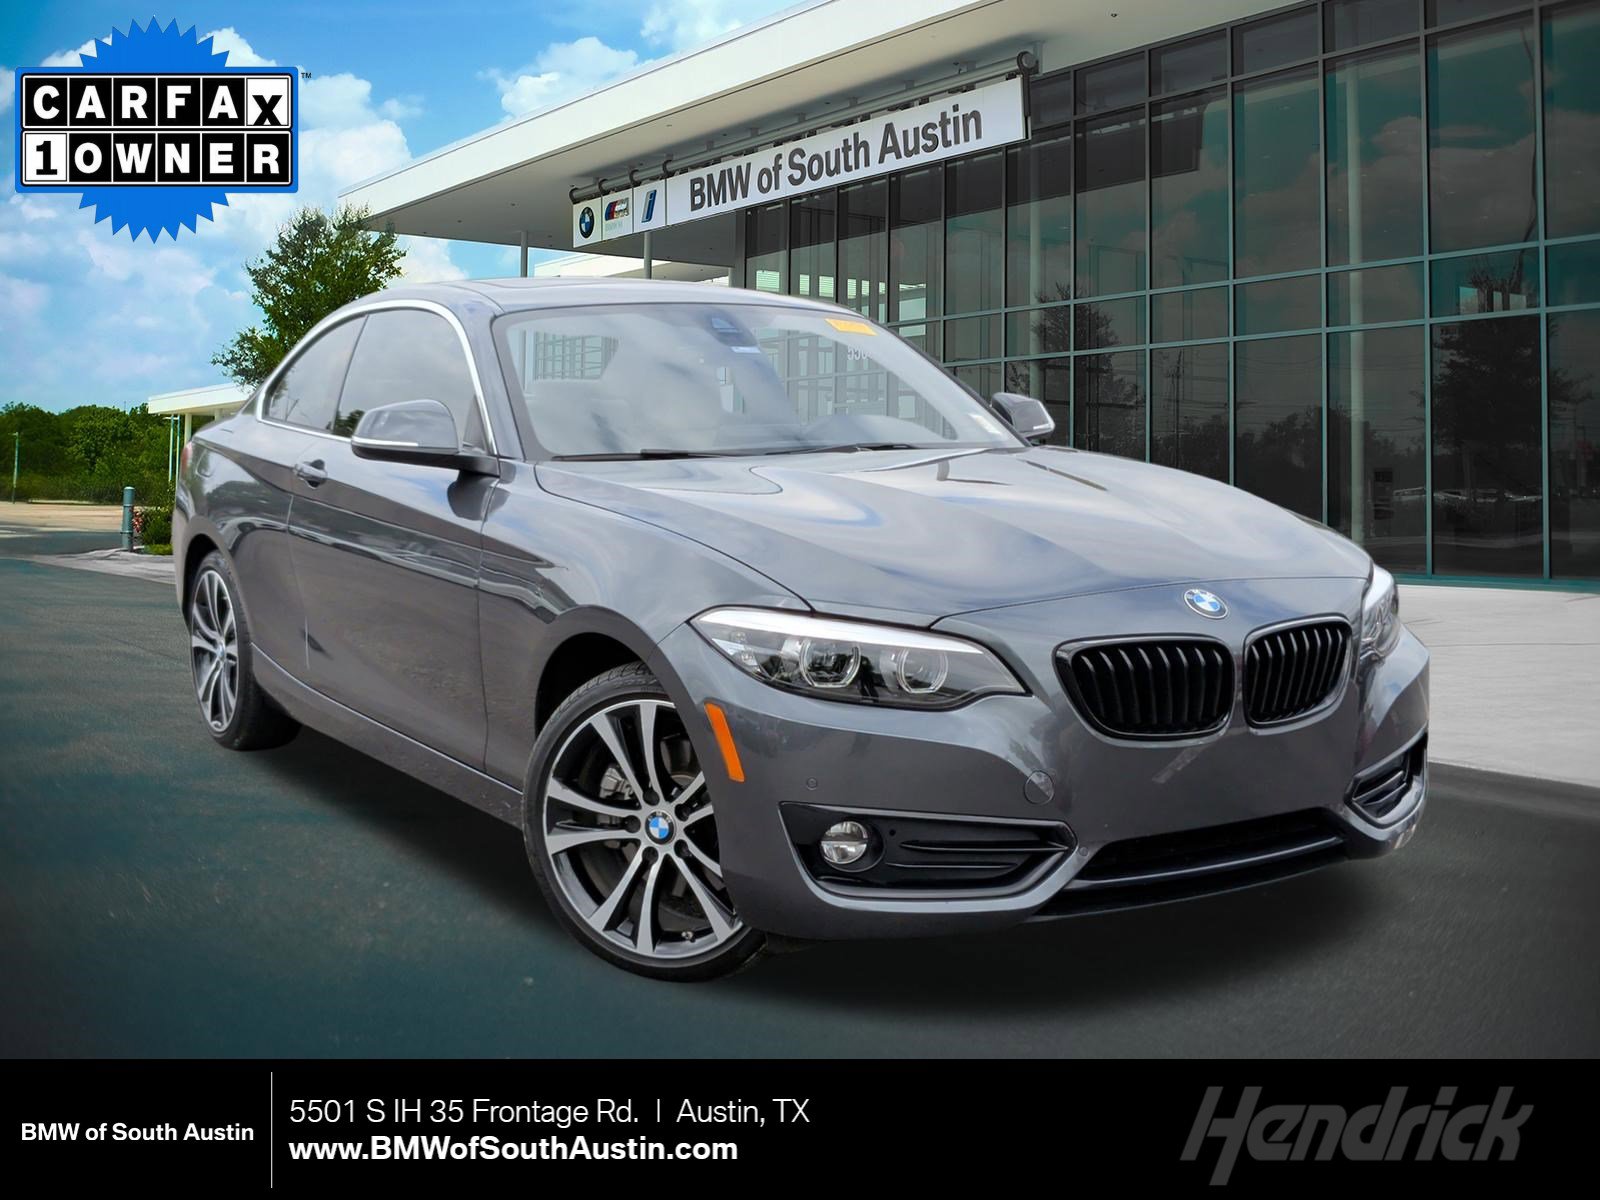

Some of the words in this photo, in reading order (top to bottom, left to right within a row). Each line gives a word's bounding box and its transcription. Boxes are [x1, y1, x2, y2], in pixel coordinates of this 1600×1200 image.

[690, 162, 752, 212] BMW
[757, 152, 784, 195] of
[787, 132, 872, 187] South
[877, 103, 983, 165] Austin
